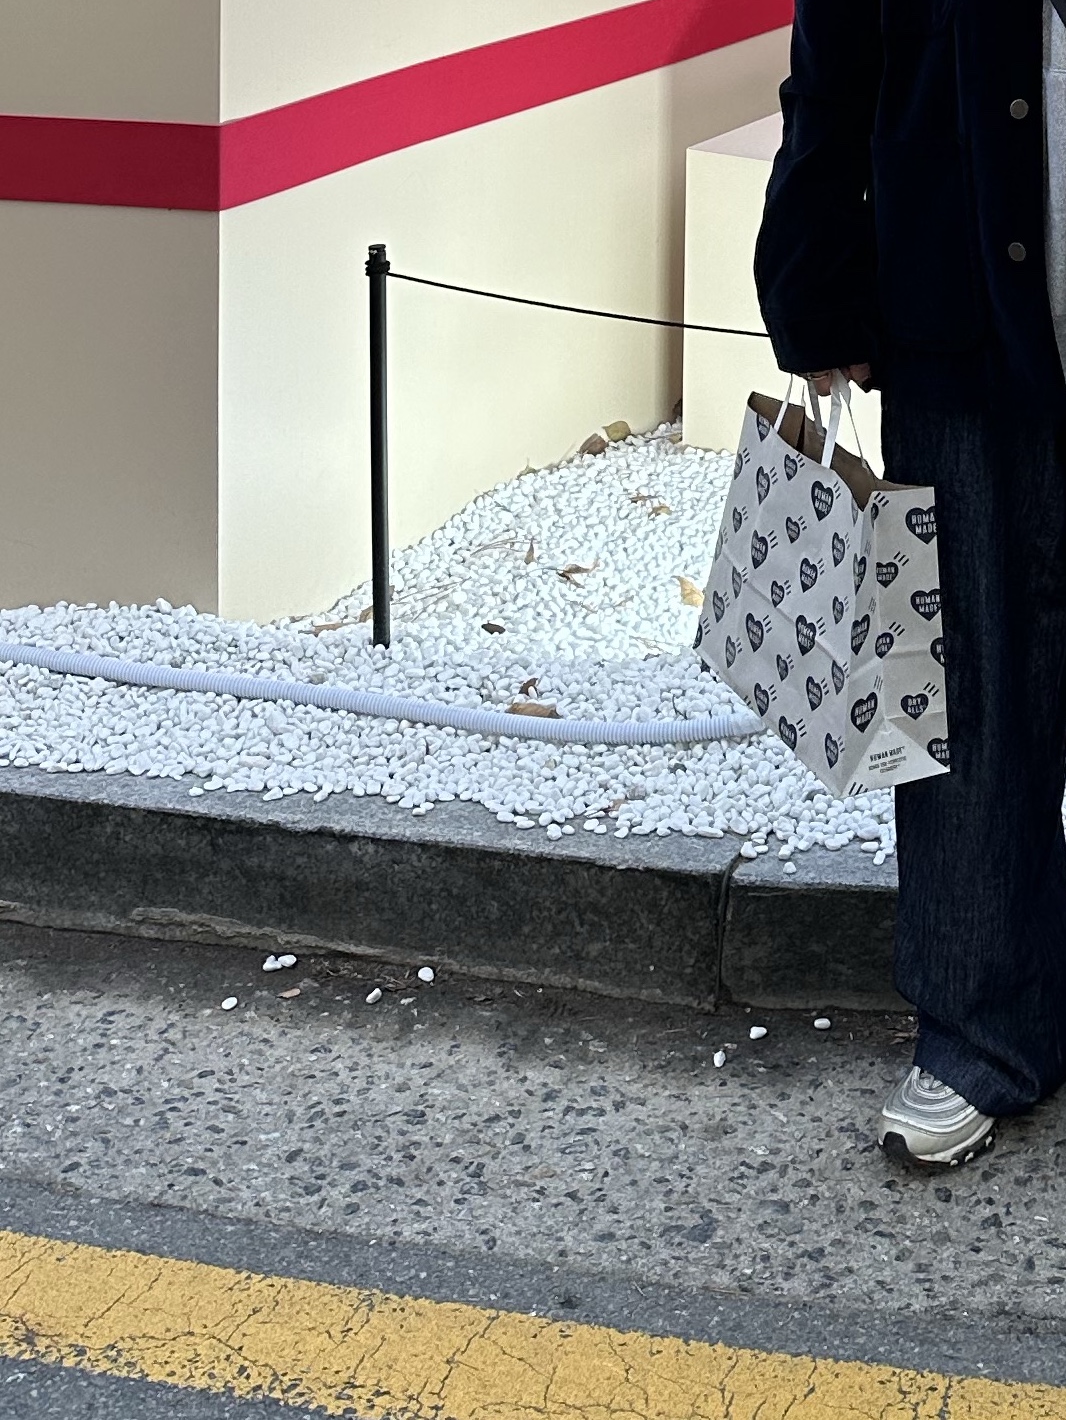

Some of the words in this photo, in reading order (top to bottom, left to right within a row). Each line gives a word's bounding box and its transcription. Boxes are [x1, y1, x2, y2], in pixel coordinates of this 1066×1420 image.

[911, 512, 936, 525] HUMA
[915, 594, 941, 605] HUMAN
[918, 603, 938, 613] MADE
[931, 742, 948, 752] HUM
